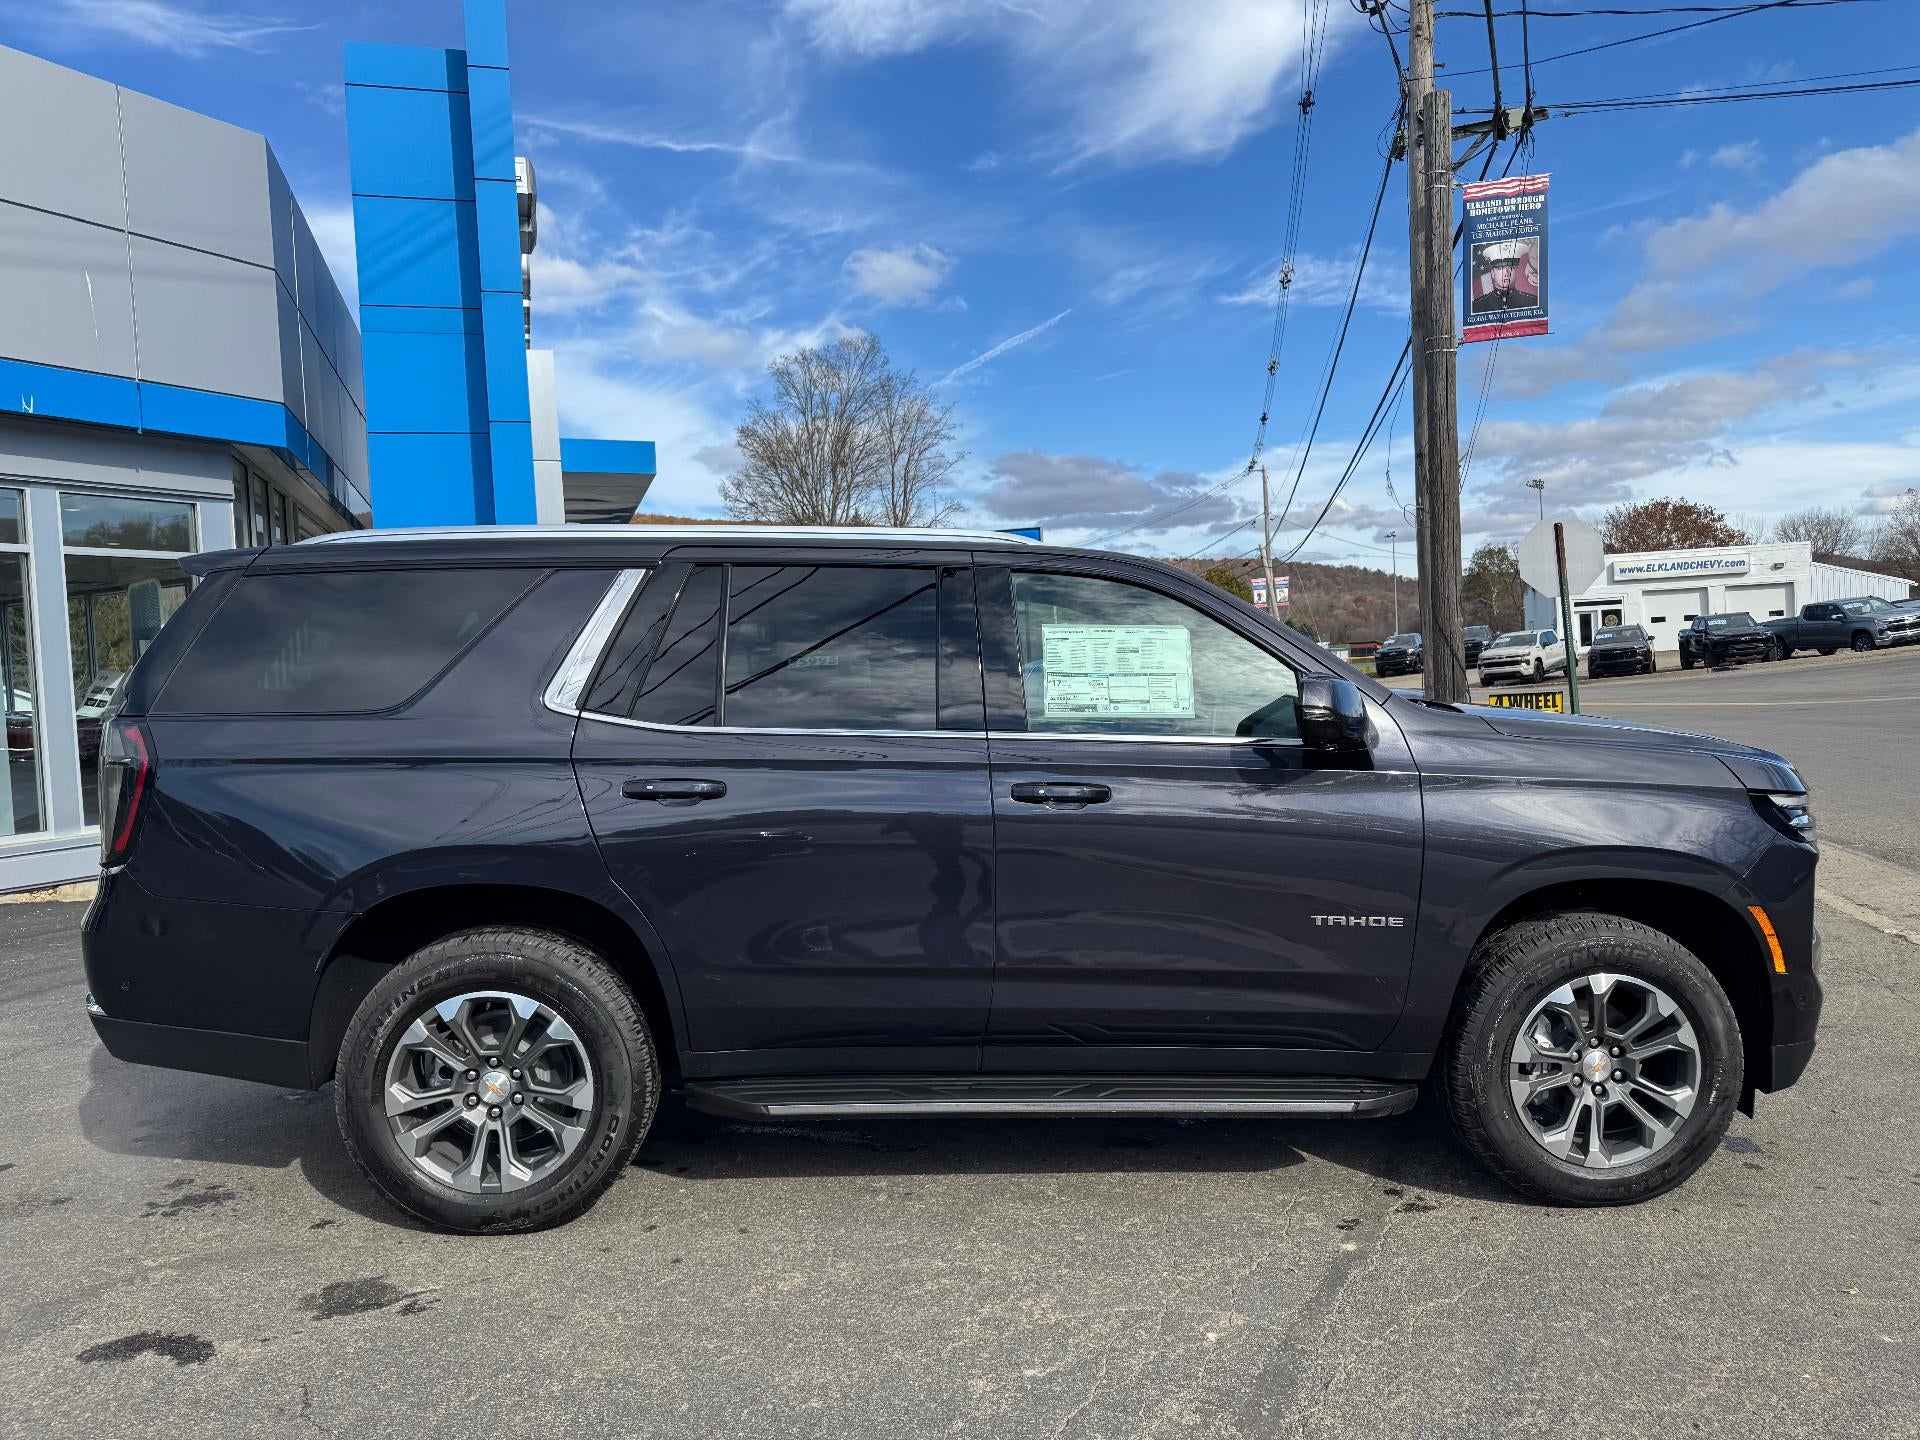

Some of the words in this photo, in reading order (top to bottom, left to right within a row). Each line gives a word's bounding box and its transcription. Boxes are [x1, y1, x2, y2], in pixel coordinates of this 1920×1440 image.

[1466, 199, 1502, 210] ELKLAND
[1504, 195, 1545, 206] BOROUGH
[1469, 204, 1516, 217] HOMETOWN
[1518, 202, 1542, 211] HERO
[1476, 220, 1510, 230] MICHAEL
[1510, 217, 1534, 227] PLANK
[1485, 228, 1514, 238] MARINE
[1618, 559, 1746, 575] www.ELKLANDCHEVY.com
[1508, 691, 1559, 710] WHEEL
[1310, 915, 1405, 927] TAHOE
